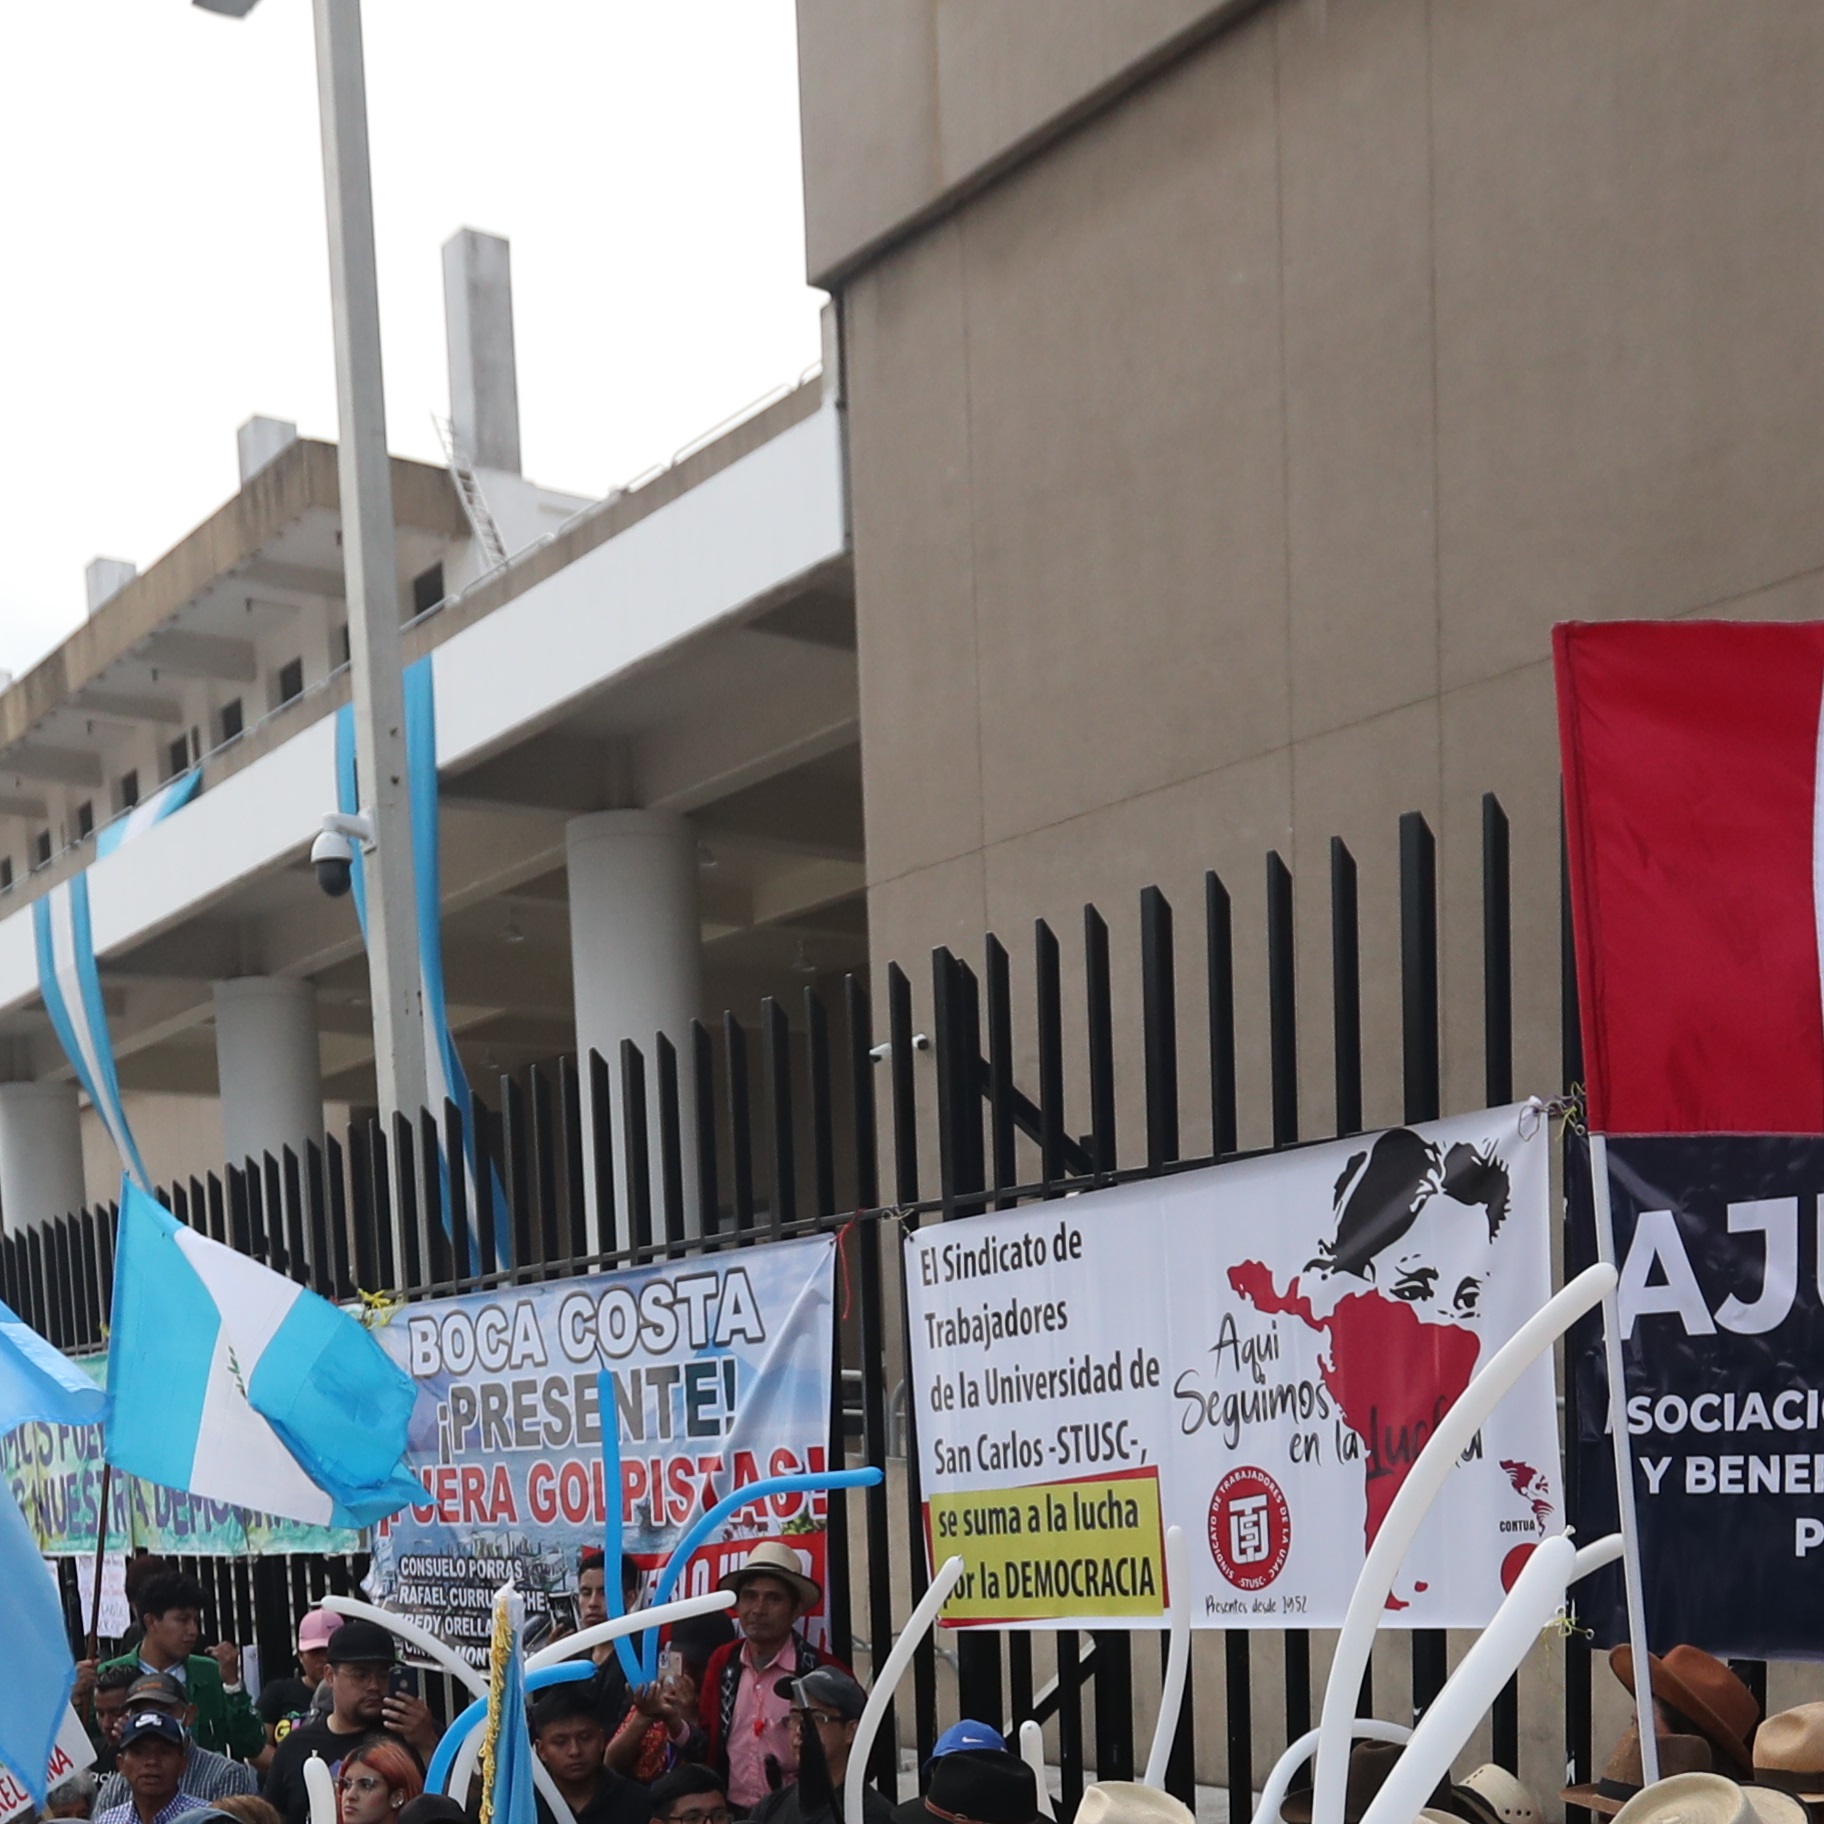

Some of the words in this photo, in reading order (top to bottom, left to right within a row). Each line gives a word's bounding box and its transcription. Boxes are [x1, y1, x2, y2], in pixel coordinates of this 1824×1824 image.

[920, 1247, 937, 1288] El
[943, 1231, 1048, 1283] Sindicato
[1053, 1221, 1084, 1263] de
[409, 1299, 547, 1377] BOCA
[558, 1266, 765, 1363] COSTA
[924, 1297, 1069, 1352] Trabajadores
[930, 1372, 954, 1412] de
[958, 1368, 980, 1408] la
[984, 1350, 1125, 1406] Universidad
[1130, 1347, 1161, 1389] de
[438, 1358, 737, 1462] ¡PRESENTE!
[1174, 1369, 1330, 1450] Seguimos
[933, 1433, 974, 1475] San
[977, 1425, 1044, 1473] Carlos
[1048, 1419, 1148, 1467] -STUSC-,
[1289, 1432, 1322, 1467] en
[1336, 1419, 1360, 1465] la
[1638, 1456, 1672, 1495] Y
[938, 1509, 961, 1539] se
[965, 1506, 1022, 1538] suma
[1026, 1504, 1042, 1534] a
[1045, 1494, 1068, 1532] la
[1073, 1490, 1140, 1531] lucha
[1499, 1519, 1536, 1533] CONTUA
[400, 1556, 466, 1578] CONSUELO
[469, 1557, 523, 1579] PORRAS
[942, 1572, 975, 1609] or
[980, 1561, 1000, 1599] la
[1005, 1554, 1156, 1600] DEMOCRACIA
[399, 1585, 447, 1606] RAFAEL
[1206, 1594, 1248, 1617] Presentes
[1252, 1596, 1278, 1614] desde
